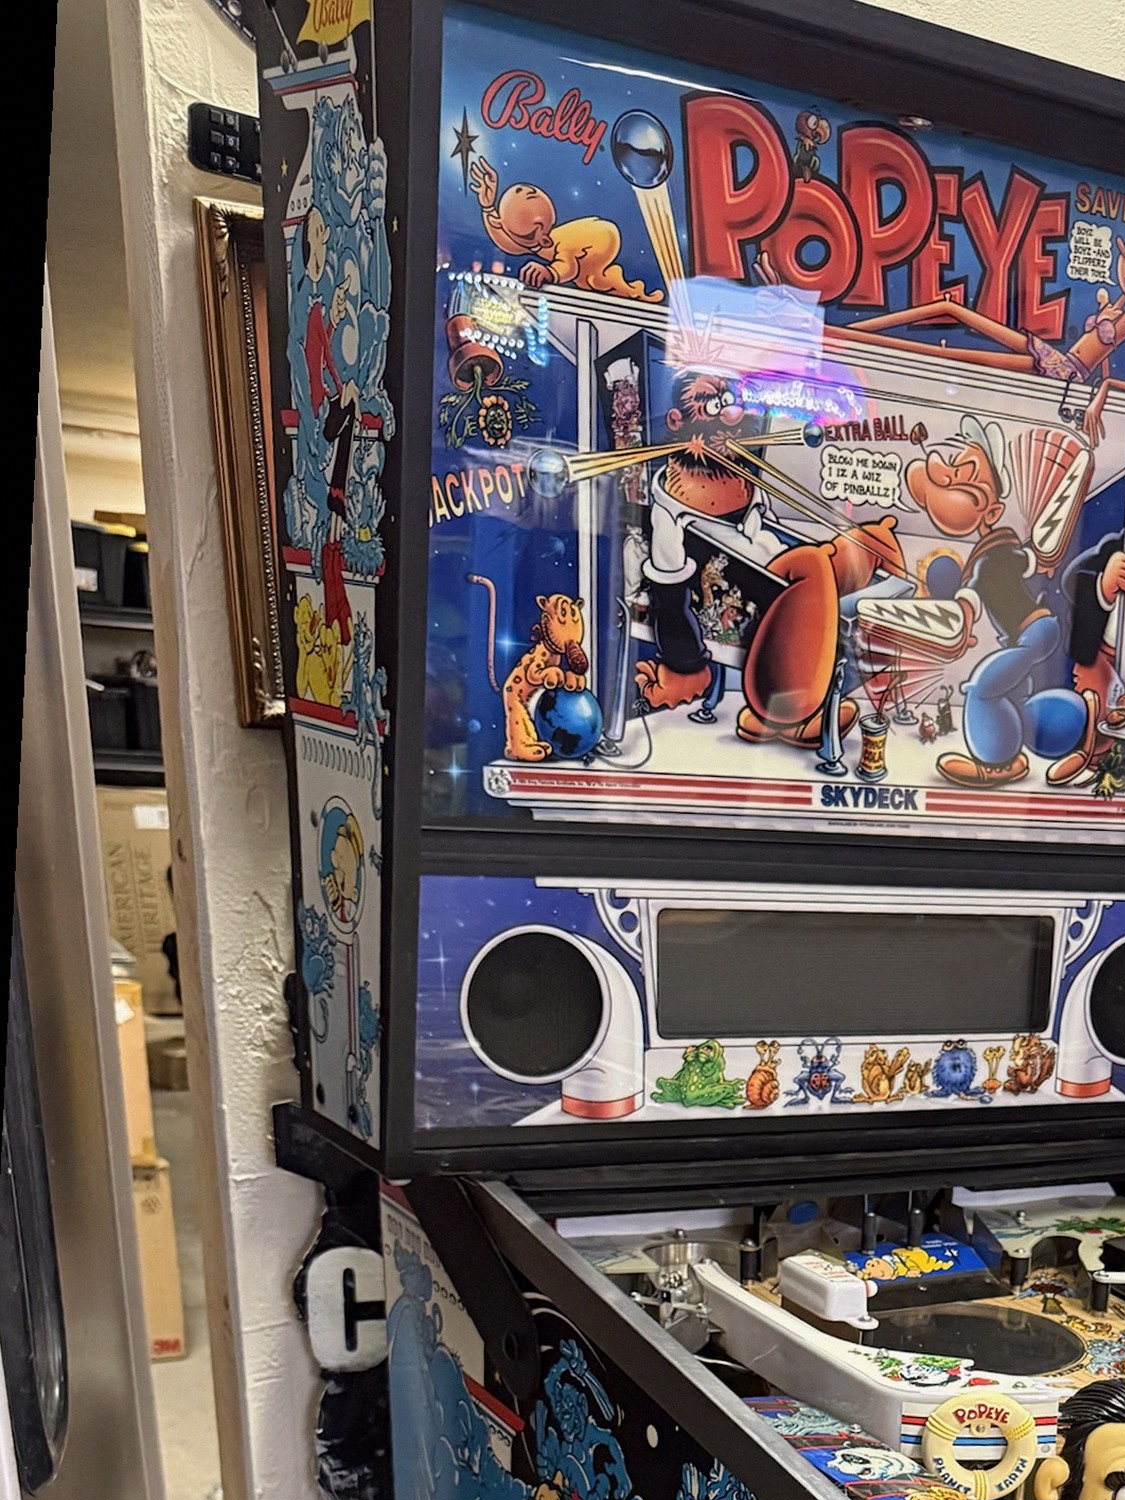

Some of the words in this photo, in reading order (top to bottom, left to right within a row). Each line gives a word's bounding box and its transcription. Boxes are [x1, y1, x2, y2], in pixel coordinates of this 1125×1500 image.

[481, 69, 608, 165] Bally
[681, 90, 1073, 341] POPEYE
[825, 420, 872, 441] EXTRA
[873, 415, 908, 441] BALL
[828, 453, 853, 464] BLOW
[856, 457, 869, 468] ME
[872, 459, 897, 472] DOWN
[828, 466, 832, 477] I
[836, 468, 848, 478] IZ
[850, 470, 858, 480] A
[862, 471, 881, 482] WIZ
[825, 481, 838, 491] OF
[821, 785, 919, 812] SKYDECK
[307, 1248, 387, 1372] C
[952, 1404, 1010, 1424] POPEYE
[934, 1457, 971, 1495] PLANET
[995, 1458, 1028, 1492] EARTH
